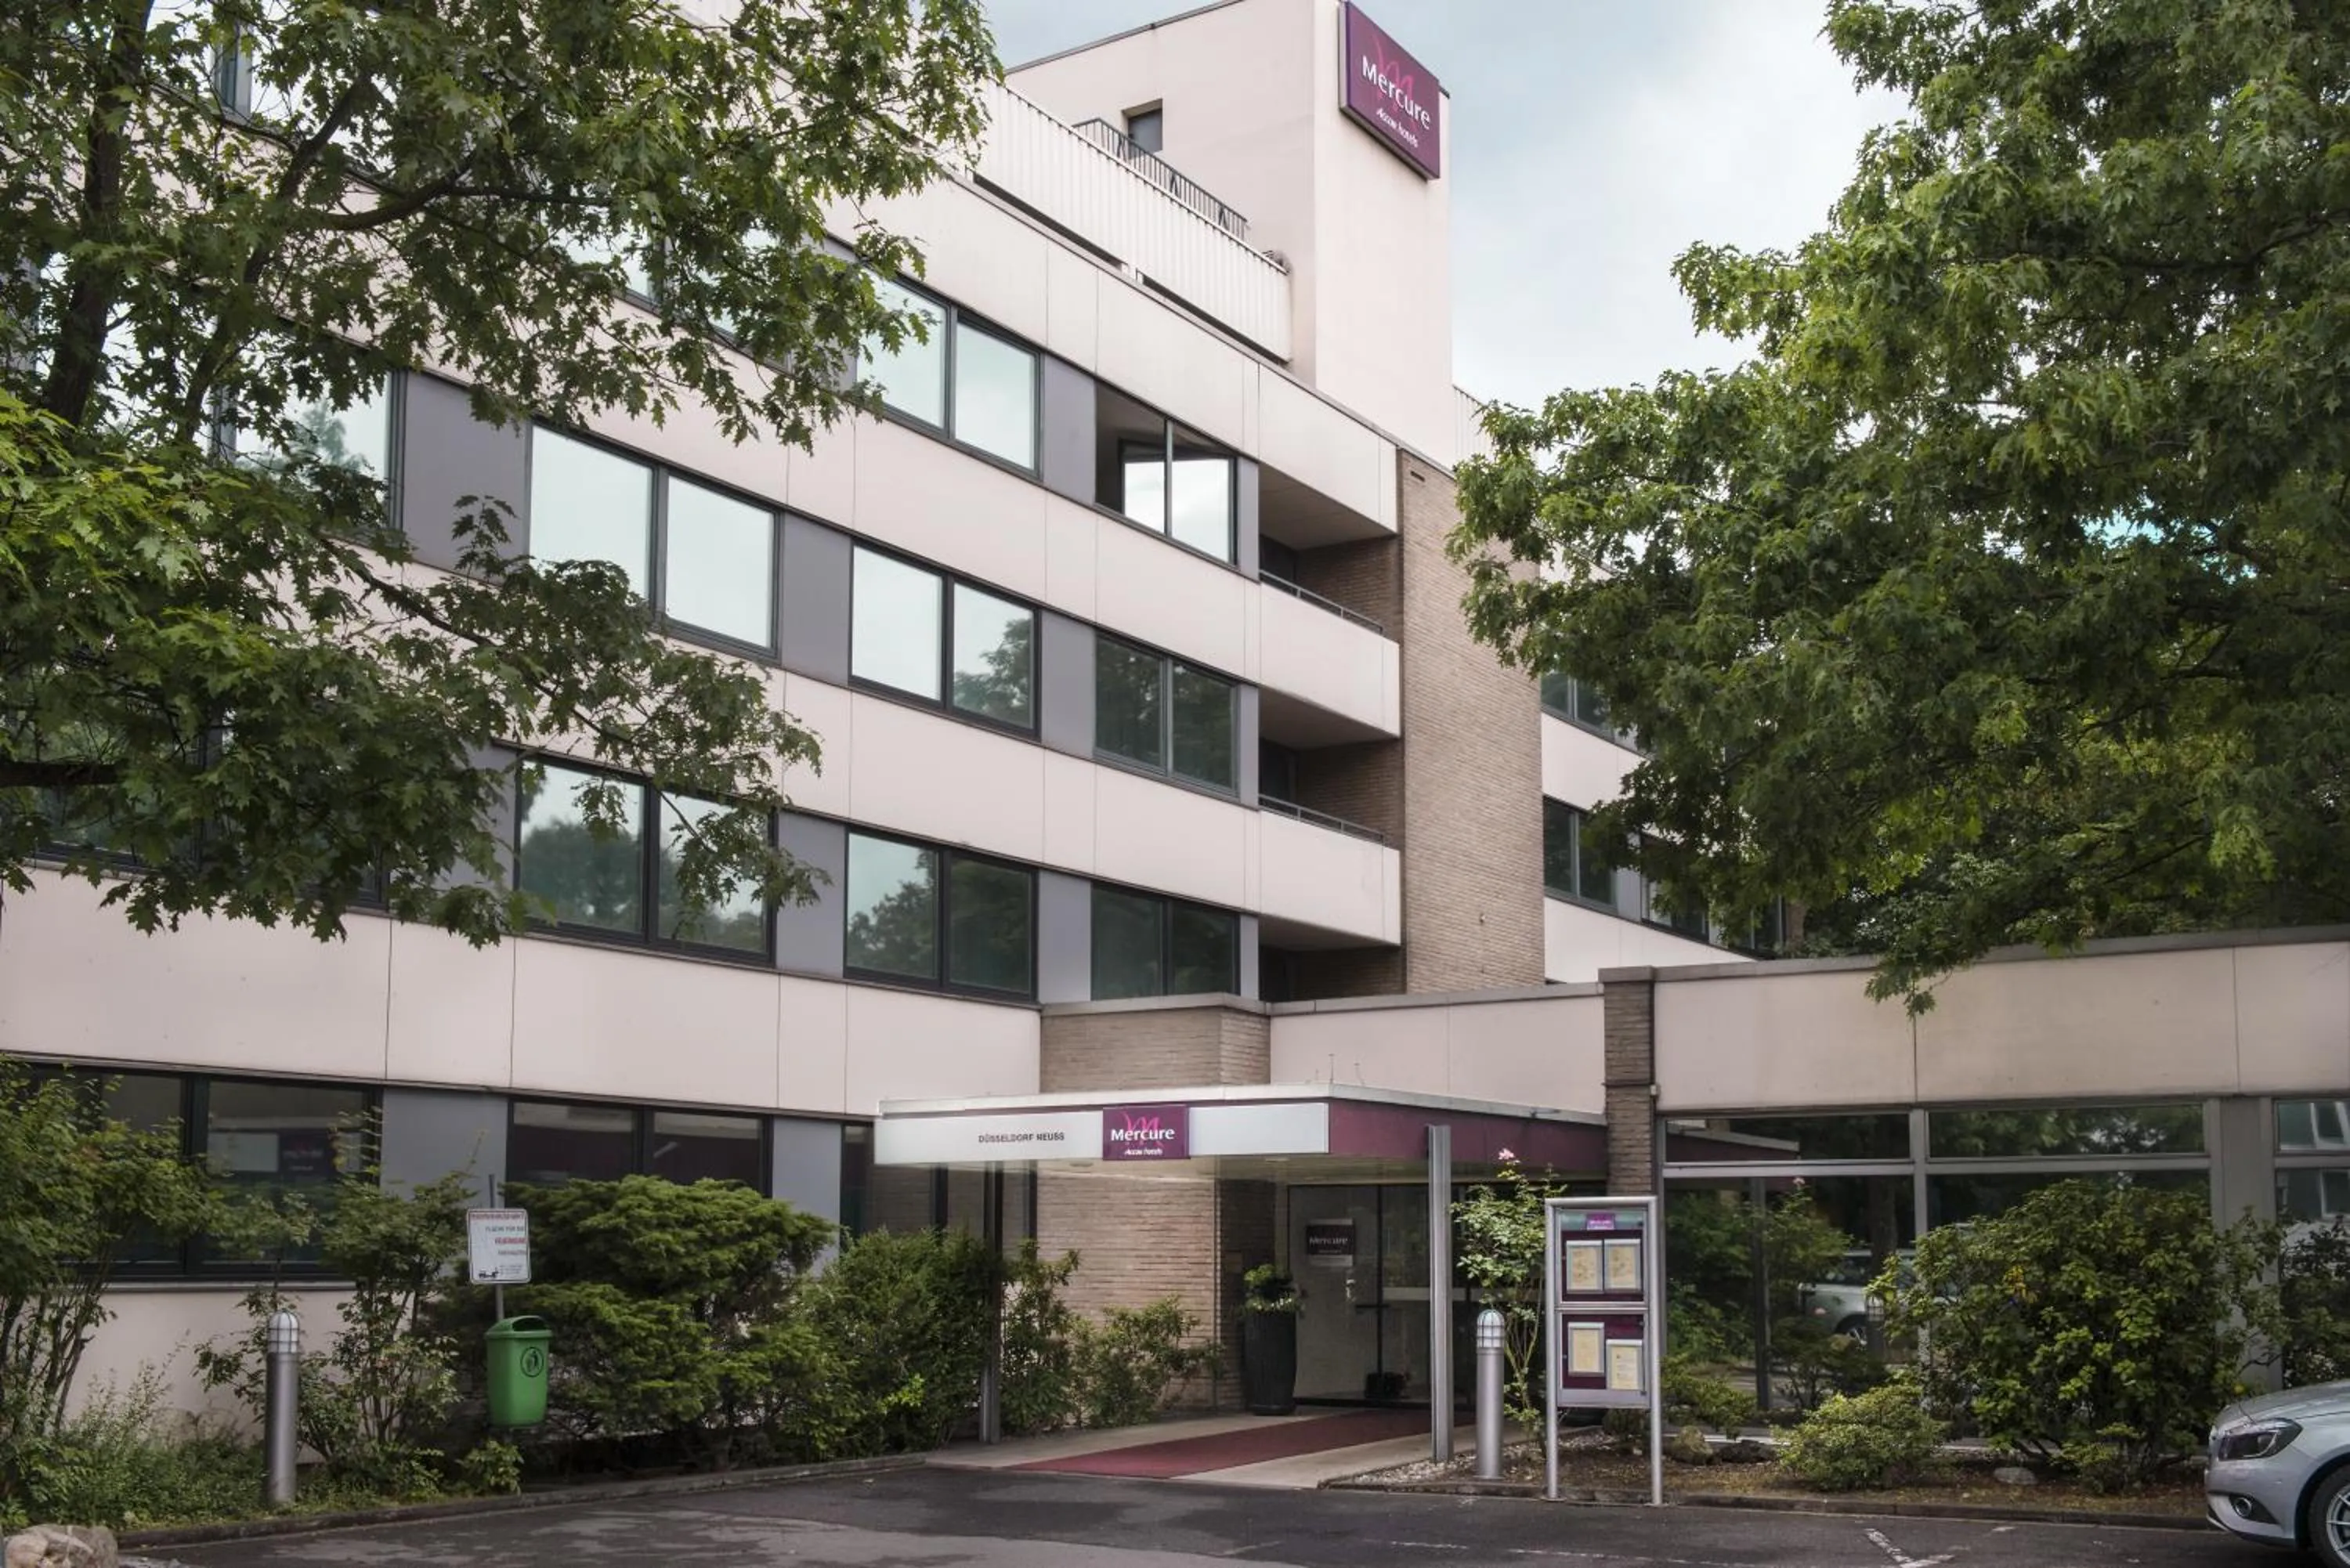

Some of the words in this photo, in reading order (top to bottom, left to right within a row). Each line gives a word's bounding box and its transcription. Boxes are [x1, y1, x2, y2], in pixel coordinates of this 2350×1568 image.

[1361, 55, 1430, 130] Mercure
[978, 1133, 1035, 1143] DÜSSELDORF
[1036, 1132, 1065, 1142] NEUSS
[1111, 1128, 1175, 1141] Mercure
